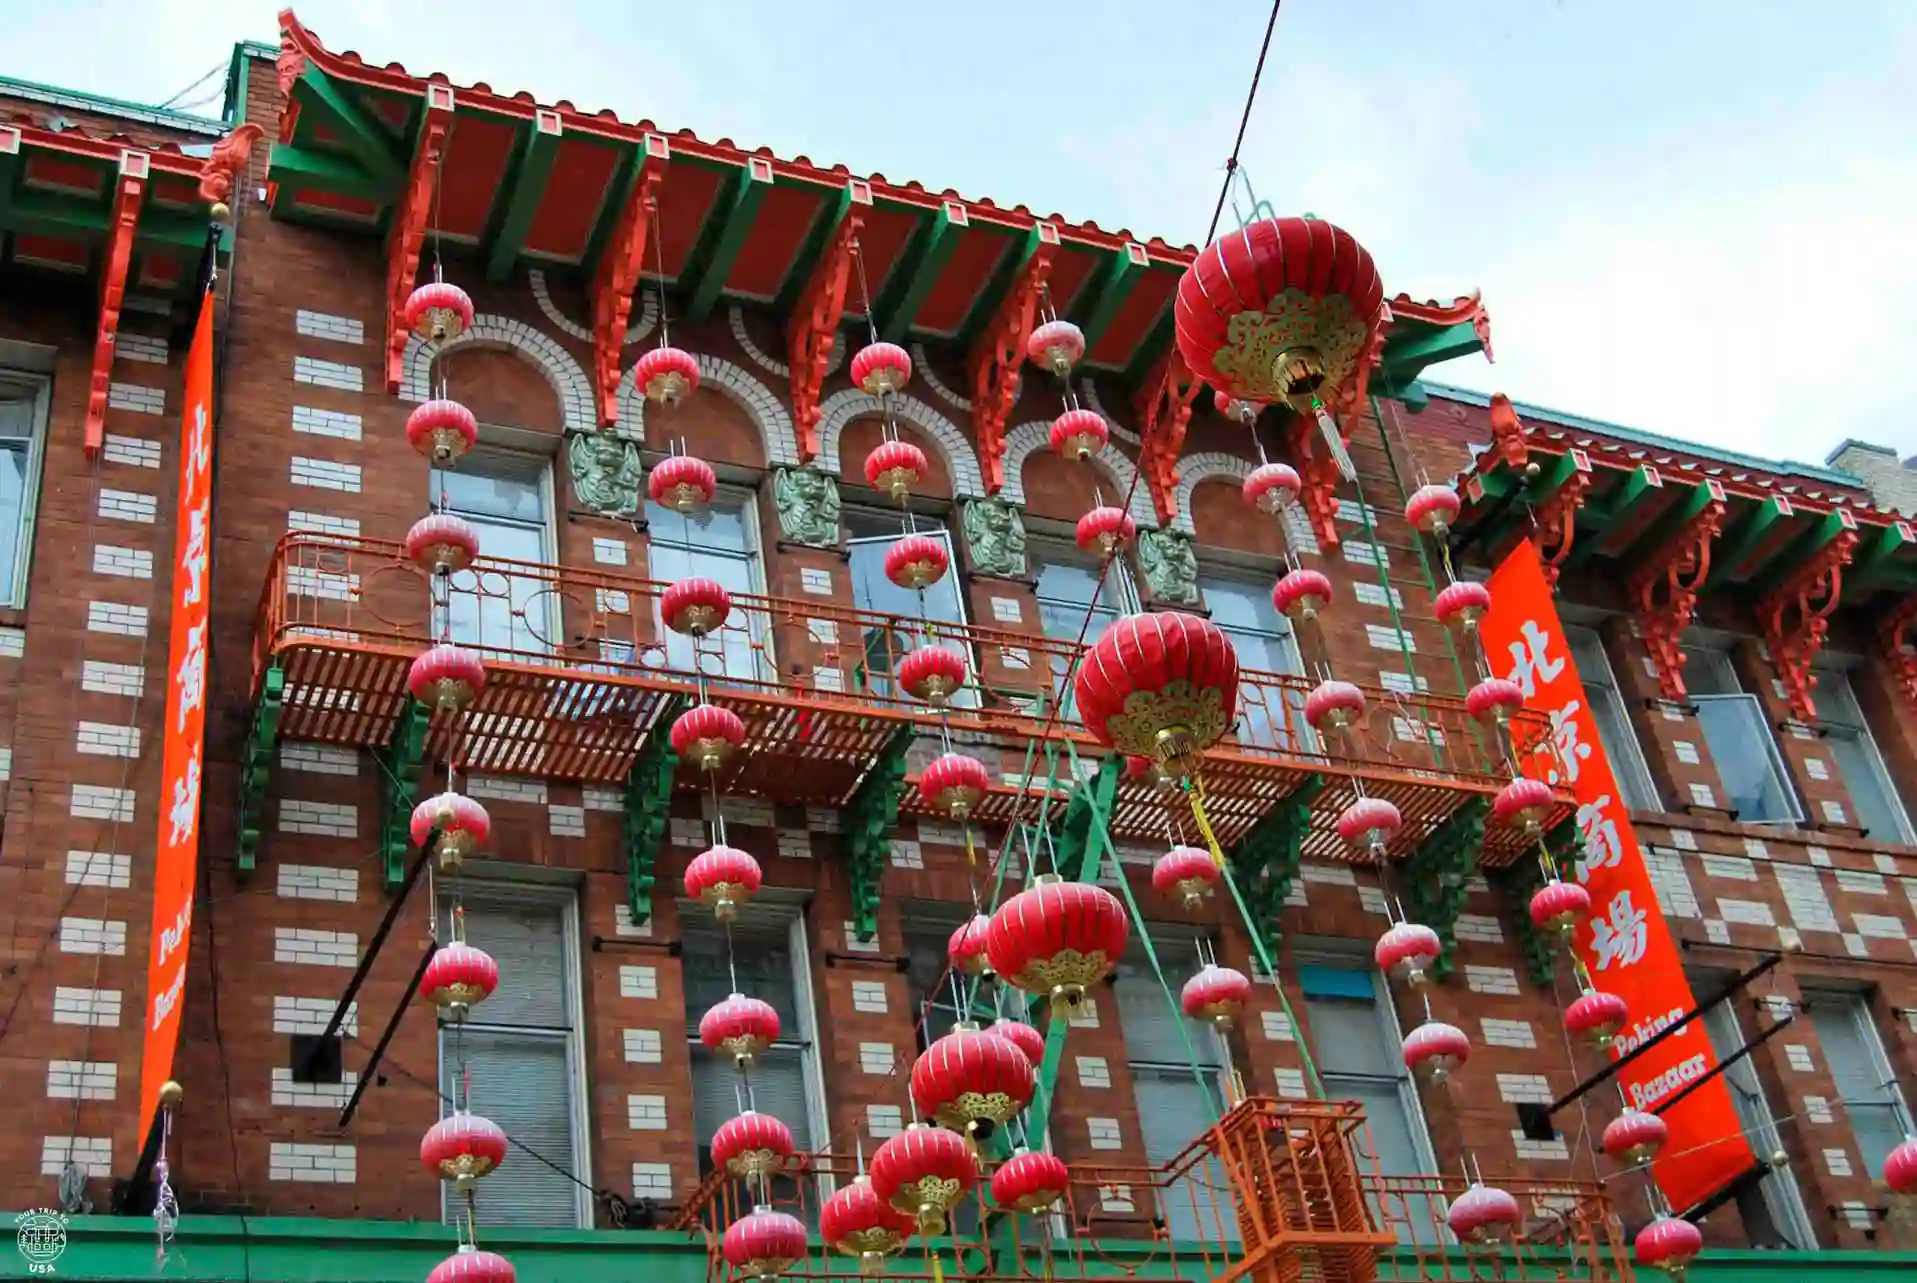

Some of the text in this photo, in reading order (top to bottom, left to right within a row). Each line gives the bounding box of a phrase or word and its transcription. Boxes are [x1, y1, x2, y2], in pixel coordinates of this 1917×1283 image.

[1508, 619, 1648, 971] 北京商場
[1613, 1007, 1688, 1058] Peking
[1629, 1053, 1705, 1111] Bazaar
